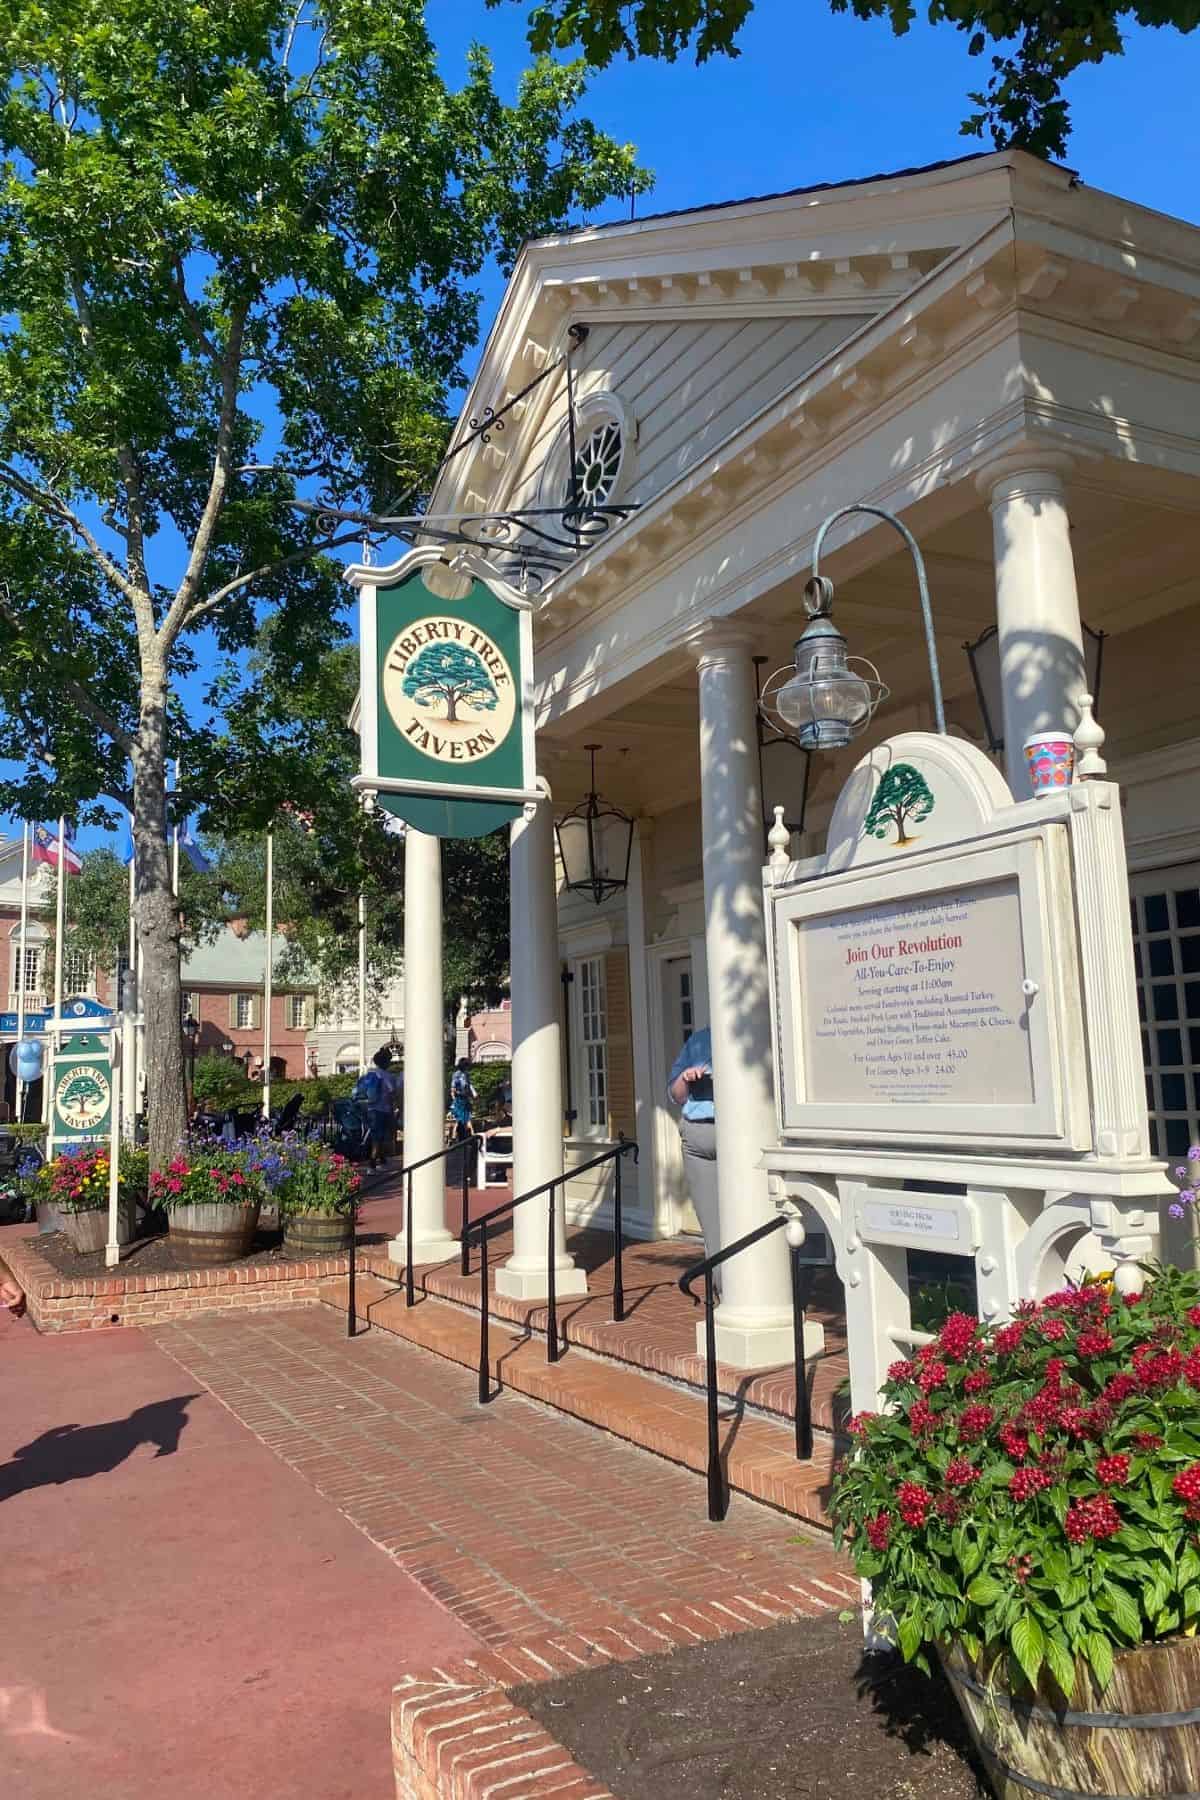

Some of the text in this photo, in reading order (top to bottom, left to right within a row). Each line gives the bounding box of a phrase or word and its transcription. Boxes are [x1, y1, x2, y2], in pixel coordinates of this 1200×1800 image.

[389, 621, 510, 687] LIBERTY TREE
[405, 717, 496, 759] TAVERN
[846, 933, 963, 965] Join Our Revolution
[855, 958, 955, 981] All-You-Care-To-Enjoy
[64, 1111, 102, 1129] TAVERN
